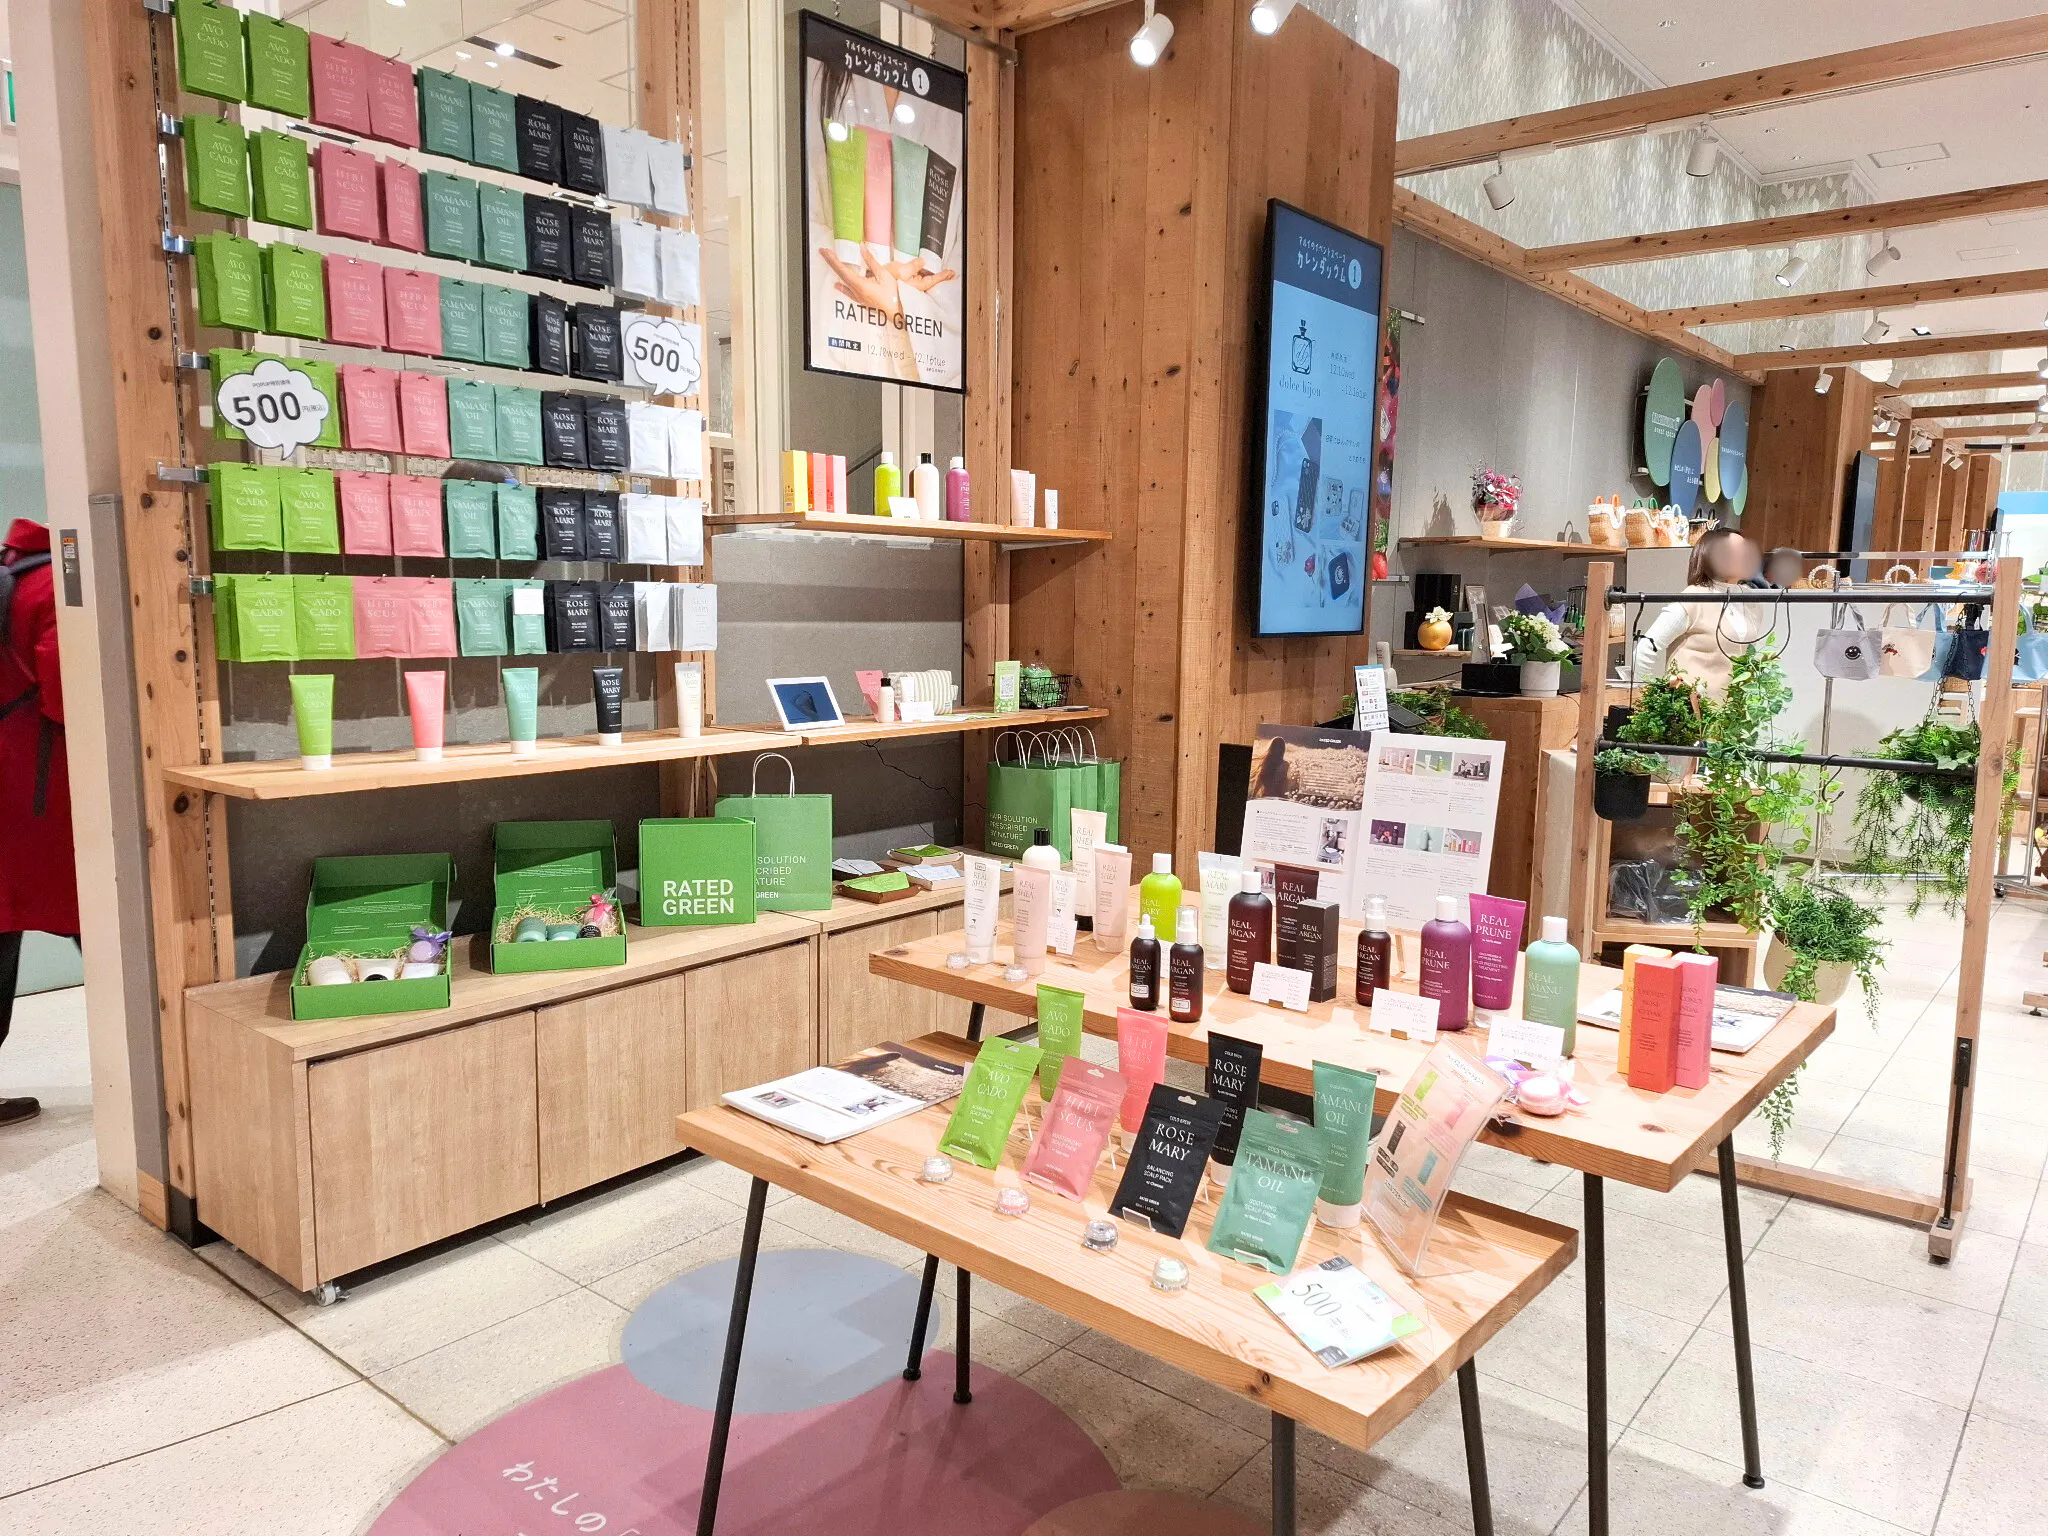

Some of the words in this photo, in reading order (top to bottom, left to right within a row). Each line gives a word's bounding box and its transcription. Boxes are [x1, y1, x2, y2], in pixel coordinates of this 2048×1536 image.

[201, 23, 223, 36] AVO
[197, 32, 229, 49] CADO
[268, 41, 289, 55] AVO
[265, 50, 295, 66] CADO
[845, 53, 909, 88] カレンダリウム
[528, 119, 551, 131] ROSE
[528, 129, 551, 140] MARY
[573, 133, 594, 143] ROSE
[211, 140, 233, 154] AVO
[574, 142, 595, 153] MARY
[209, 151, 238, 166] CADO
[929, 168, 949, 188] ROSE
[928, 179, 949, 198] MARY
[535, 217, 559, 227] ROSE
[537, 227, 559, 236] MARY
[582, 227, 604, 238] ROSE
[583, 236, 605, 247] MARY
[227, 259, 246, 270] AVO
[1297, 250, 1346, 283] カレンダリウム
[224, 268, 251, 281] CADO
[289, 270, 309, 279] AVO
[286, 279, 314, 291] CADO
[440, 299, 476, 312] TAMANU
[450, 311, 465, 320] OIL
[488, 305, 524, 319] TAMANU
[500, 317, 515, 327] OIL
[545, 316, 560, 327] ROSE
[835, 300, 887, 327] RATED
[893, 312, 943, 338] GREEN
[546, 325, 561, 335] MARY
[589, 325, 611, 333] ROSE
[589, 333, 611, 342] MARY
[633, 338, 679, 372] 500
[233, 392, 301, 426] 500
[553, 412, 575, 422] ROSE
[597, 416, 618, 426] ROSE
[555, 422, 576, 431] MARY
[598, 426, 618, 435] MARY
[240, 487, 263, 496] AVO
[299, 490, 319, 499] AVO
[236, 497, 268, 506] CADO
[294, 500, 324, 509] CADO
[553, 507, 574, 516] ROSE
[554, 516, 575, 525] MARY
[255, 598, 277, 606] AVO
[313, 598, 336, 606] AVO
[566, 600, 589, 608] ROSE
[609, 601, 628, 609] ROSE
[251, 609, 282, 617] CADO
[310, 608, 341, 617] CADO
[567, 609, 589, 617] MARY
[609, 609, 629, 617] MARY
[601, 679, 620, 687] ROSE
[602, 686, 620, 694] MARY
[1004, 814, 1038, 824] SOLUTION
[990, 821, 1028, 832] PRESCRIBED
[1076, 827, 1094, 837] REAL
[996, 831, 1023, 841] NATURE
[1075, 836, 1093, 846] SHEA
[757, 856, 806, 864] SOLUTION
[756, 867, 791, 875] CRIBED
[1103, 864, 1118, 873] REAL
[973, 871, 987, 881] REAL
[1101, 872, 1117, 881] SHEA
[664, 879, 734, 897] RATED
[972, 880, 987, 889] SHEA
[1019, 880, 1035, 889] REAL
[1282, 881, 1306, 893] REAL
[1017, 889, 1034, 899] SHEA
[663, 898, 734, 916] GREEN
[1231, 919, 1252, 930] REAL
[1481, 914, 1509, 928] REAL
[1228, 928, 1256, 939] ARGAN
[1302, 924, 1318, 932] REAL
[1475, 924, 1512, 940] PRUNE
[1299, 931, 1322, 940] ARGAN
[1359, 944, 1376, 953] REAL
[1424, 948, 1447, 959] REAL
[1357, 951, 1380, 961] ARGAN
[1131, 963, 1152, 971] ARGAN
[1172, 958, 1191, 968] REAL
[1422, 958, 1450, 969] PRUNE
[1169, 966, 1195, 976] ARGAN
[1528, 969, 1554, 984] REAL
[1046, 1010, 1068, 1022] AVO
[1040, 1022, 1070, 1036] CADO
[1214, 1058, 1247, 1078] ROSE
[986, 1070, 1010, 1084] AVO
[1212, 1073, 1245, 1092] MARY
[977, 1083, 1007, 1099] CADO
[1065, 1095, 1099, 1117] HIBI
[1315, 1091, 1368, 1114] TAMANU
[1059, 1108, 1095, 1132] SCUS
[1325, 1110, 1348, 1126] OIL
[1156, 1123, 1195, 1146] ROSE
[1148, 1139, 1190, 1161] MARY
[1146, 1164, 1174, 1177] BALANCING
[1245, 1151, 1313, 1183] TAMANU
[1144, 1170, 1159, 1179] SCALP
[1159, 1174, 1172, 1184] PACK
[1258, 1176, 1284, 1194] OIL
[1249, 1199, 1277, 1212] SOOTHING
[1244, 1204, 1262, 1213] SCALP
[1262, 1209, 1277, 1219] PACK
[1292, 1283, 1342, 1316] 500
[502, 1461, 641, 1536] わたしの
